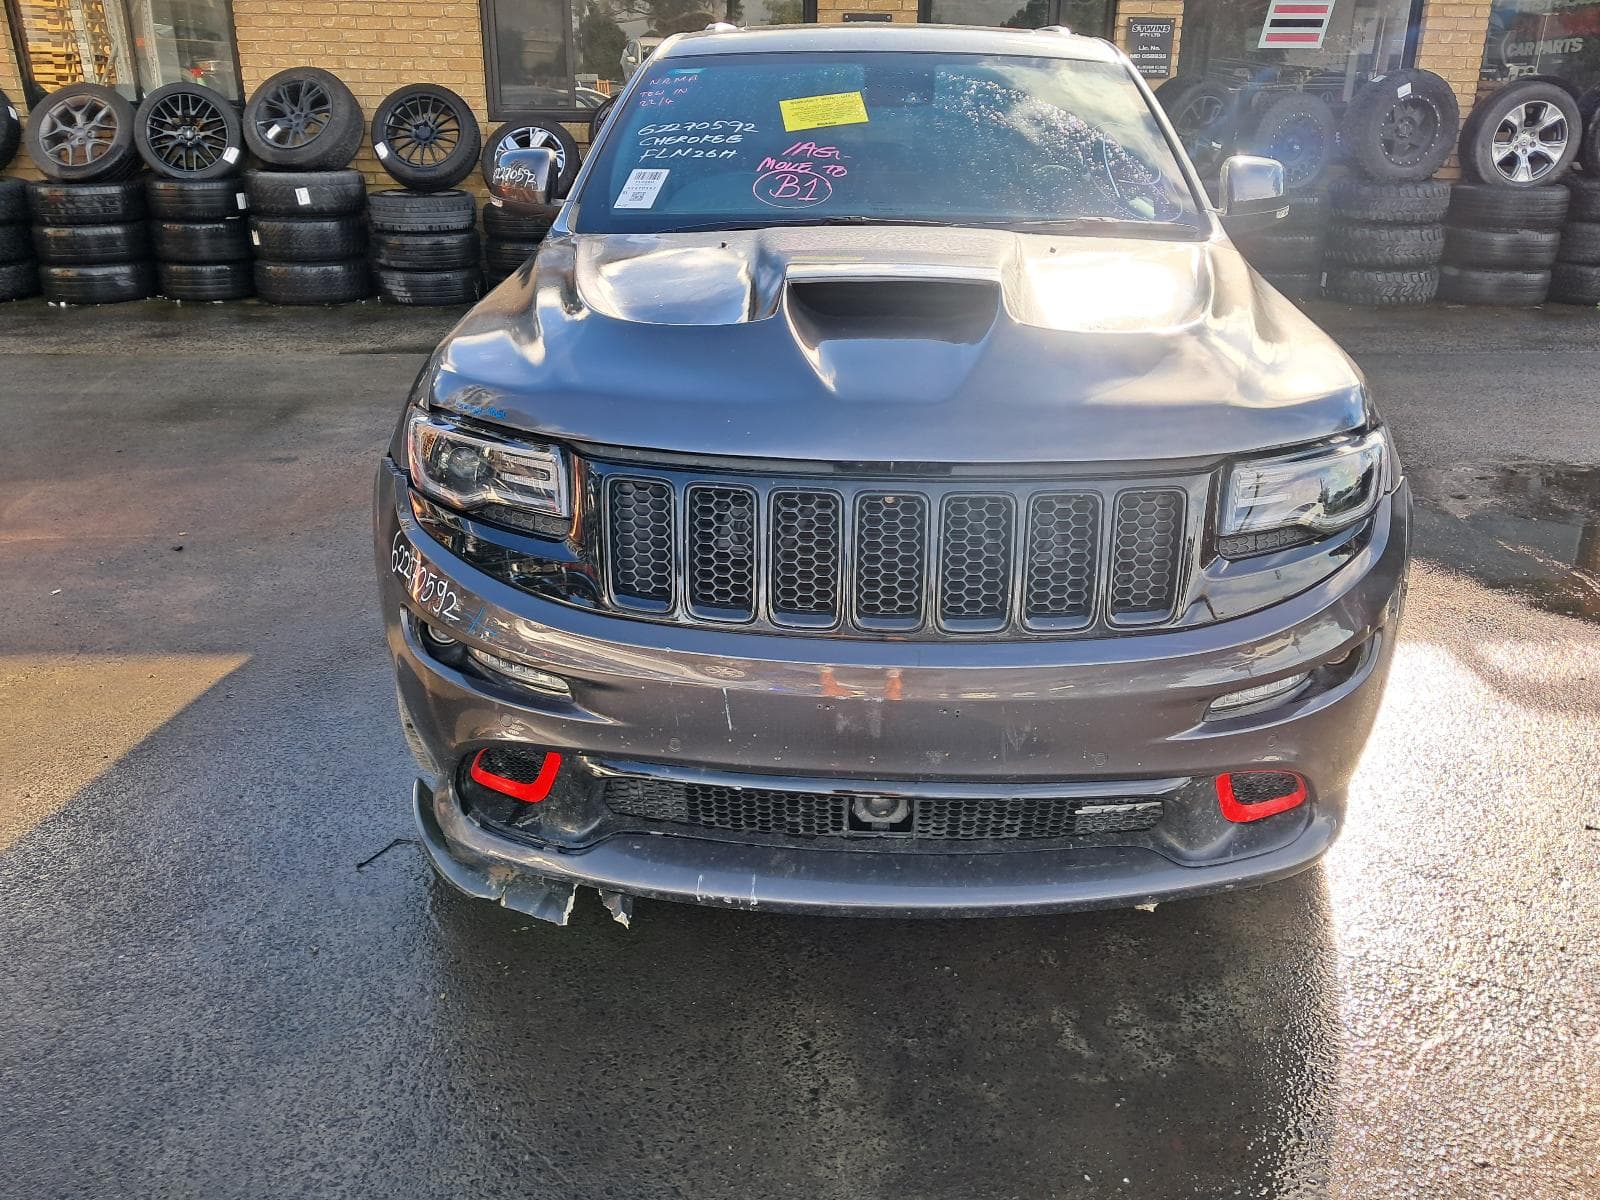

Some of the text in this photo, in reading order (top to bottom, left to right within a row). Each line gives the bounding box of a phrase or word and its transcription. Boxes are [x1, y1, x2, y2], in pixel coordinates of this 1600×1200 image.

[673, 87, 688, 96] IN
[637, 120, 760, 136] 62270592
[639, 134, 744, 146] CHEROKEE
[822, 164, 848, 178] TO
[768, 173, 819, 201] B1
